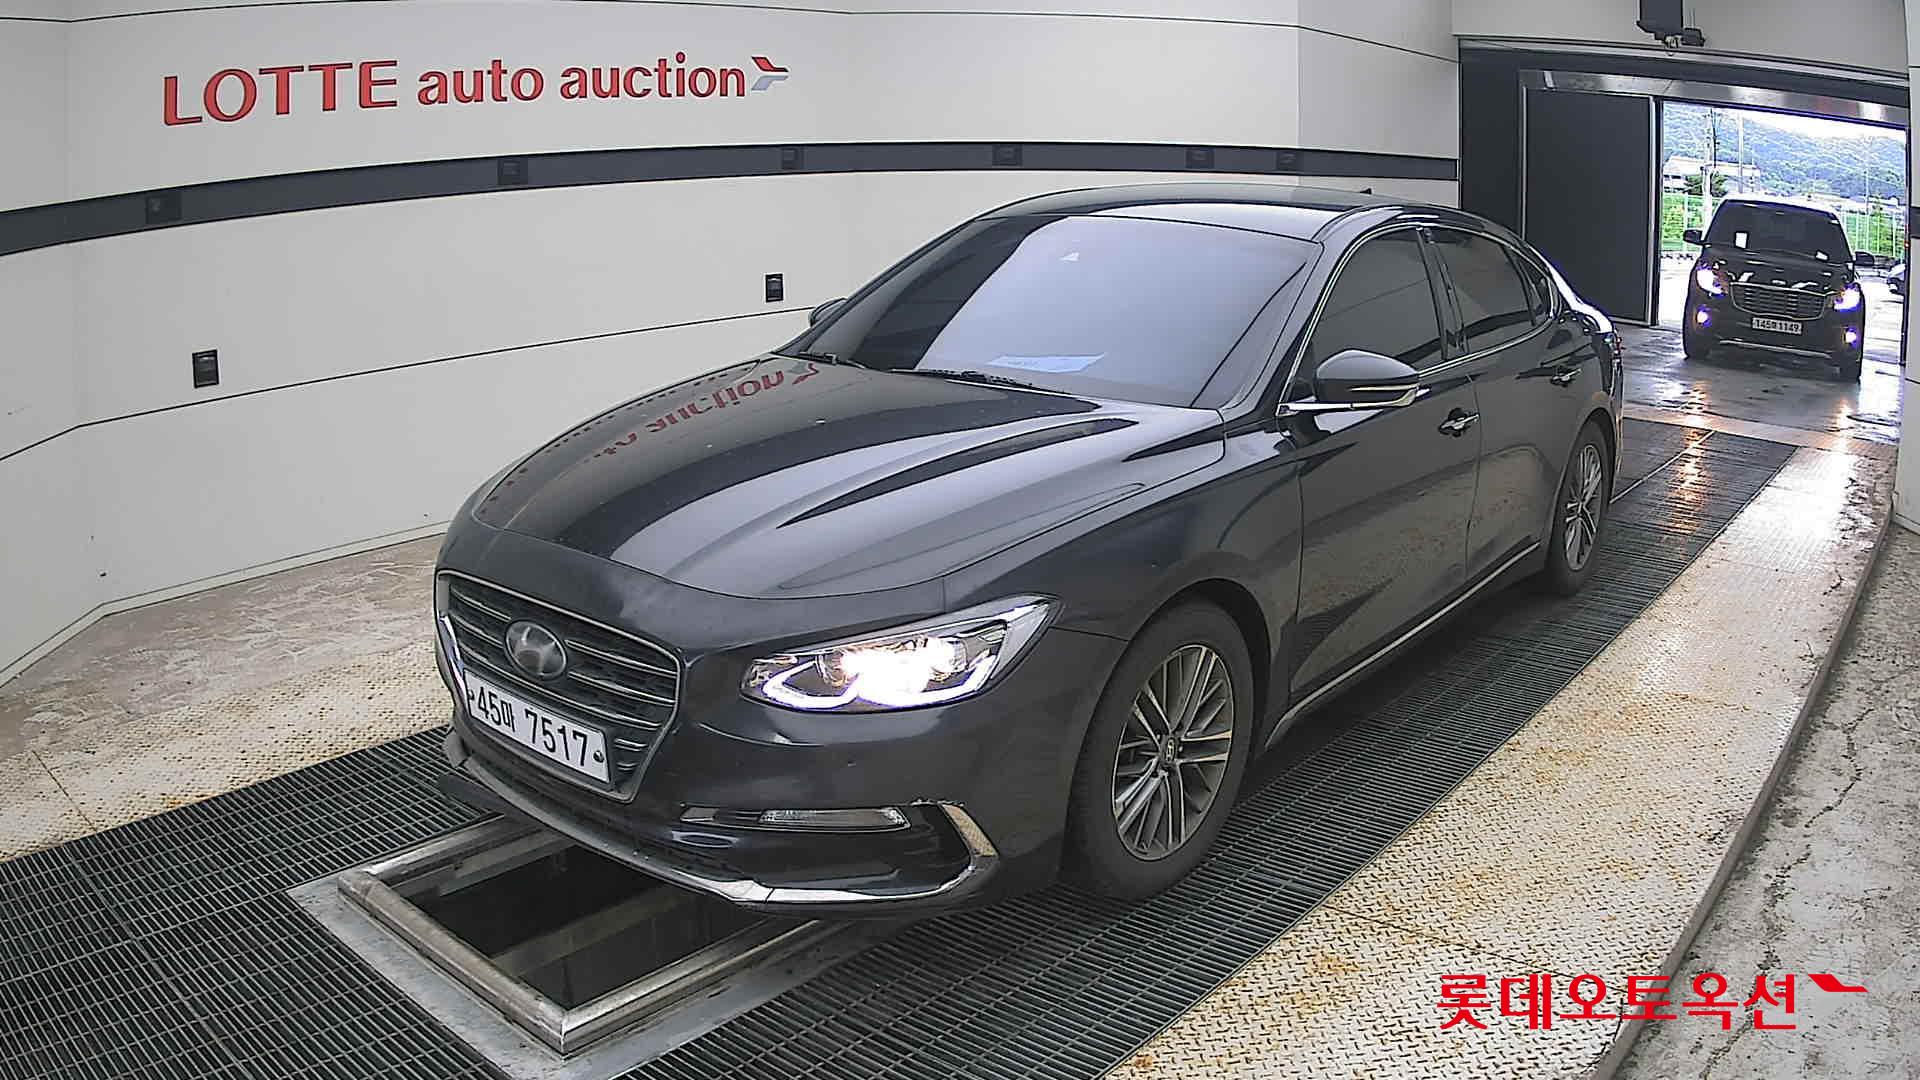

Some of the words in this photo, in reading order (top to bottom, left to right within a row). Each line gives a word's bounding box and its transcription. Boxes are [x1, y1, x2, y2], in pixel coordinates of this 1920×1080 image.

[162, 60, 397, 127] LOTTE
[417, 59, 545, 106] auto
[560, 52, 747, 101] auction
[477, 686, 516, 733] 45마
[525, 708, 588, 767] 7517
